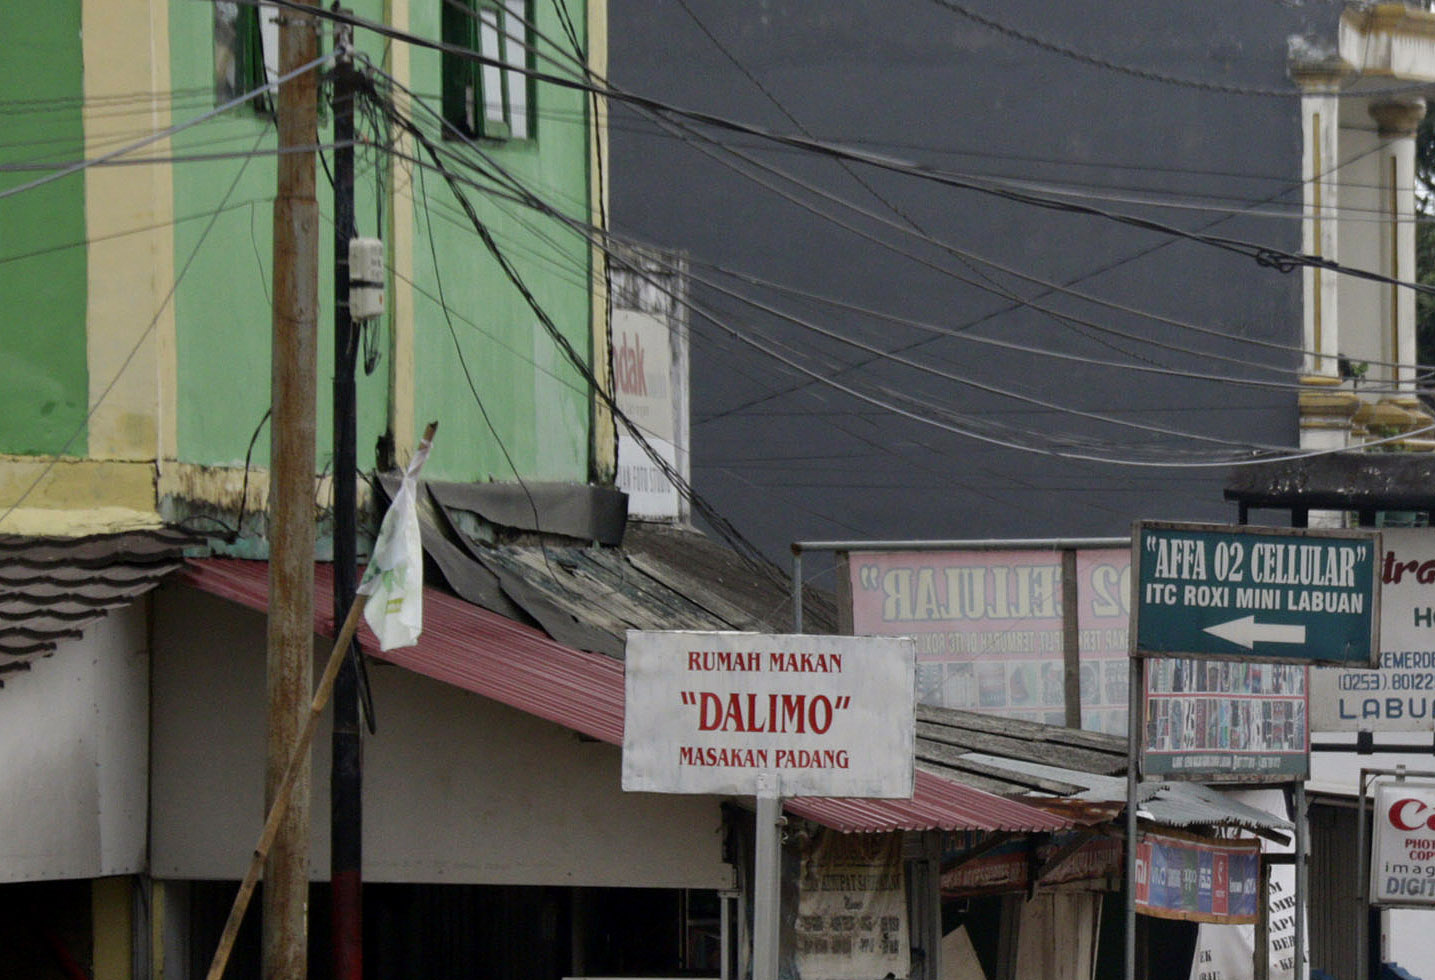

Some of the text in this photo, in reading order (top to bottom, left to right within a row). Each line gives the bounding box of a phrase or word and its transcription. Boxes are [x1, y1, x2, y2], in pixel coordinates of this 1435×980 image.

[1214, 541, 1244, 583] 02
[1145, 583, 1364, 614] ITC ROXI MINI LABUAN
[688, 651, 842, 673] RUMAH MAKAN
[681, 691, 851, 735] "DALIMO"
[680, 747, 850, 769] MASAKAN PADANG
